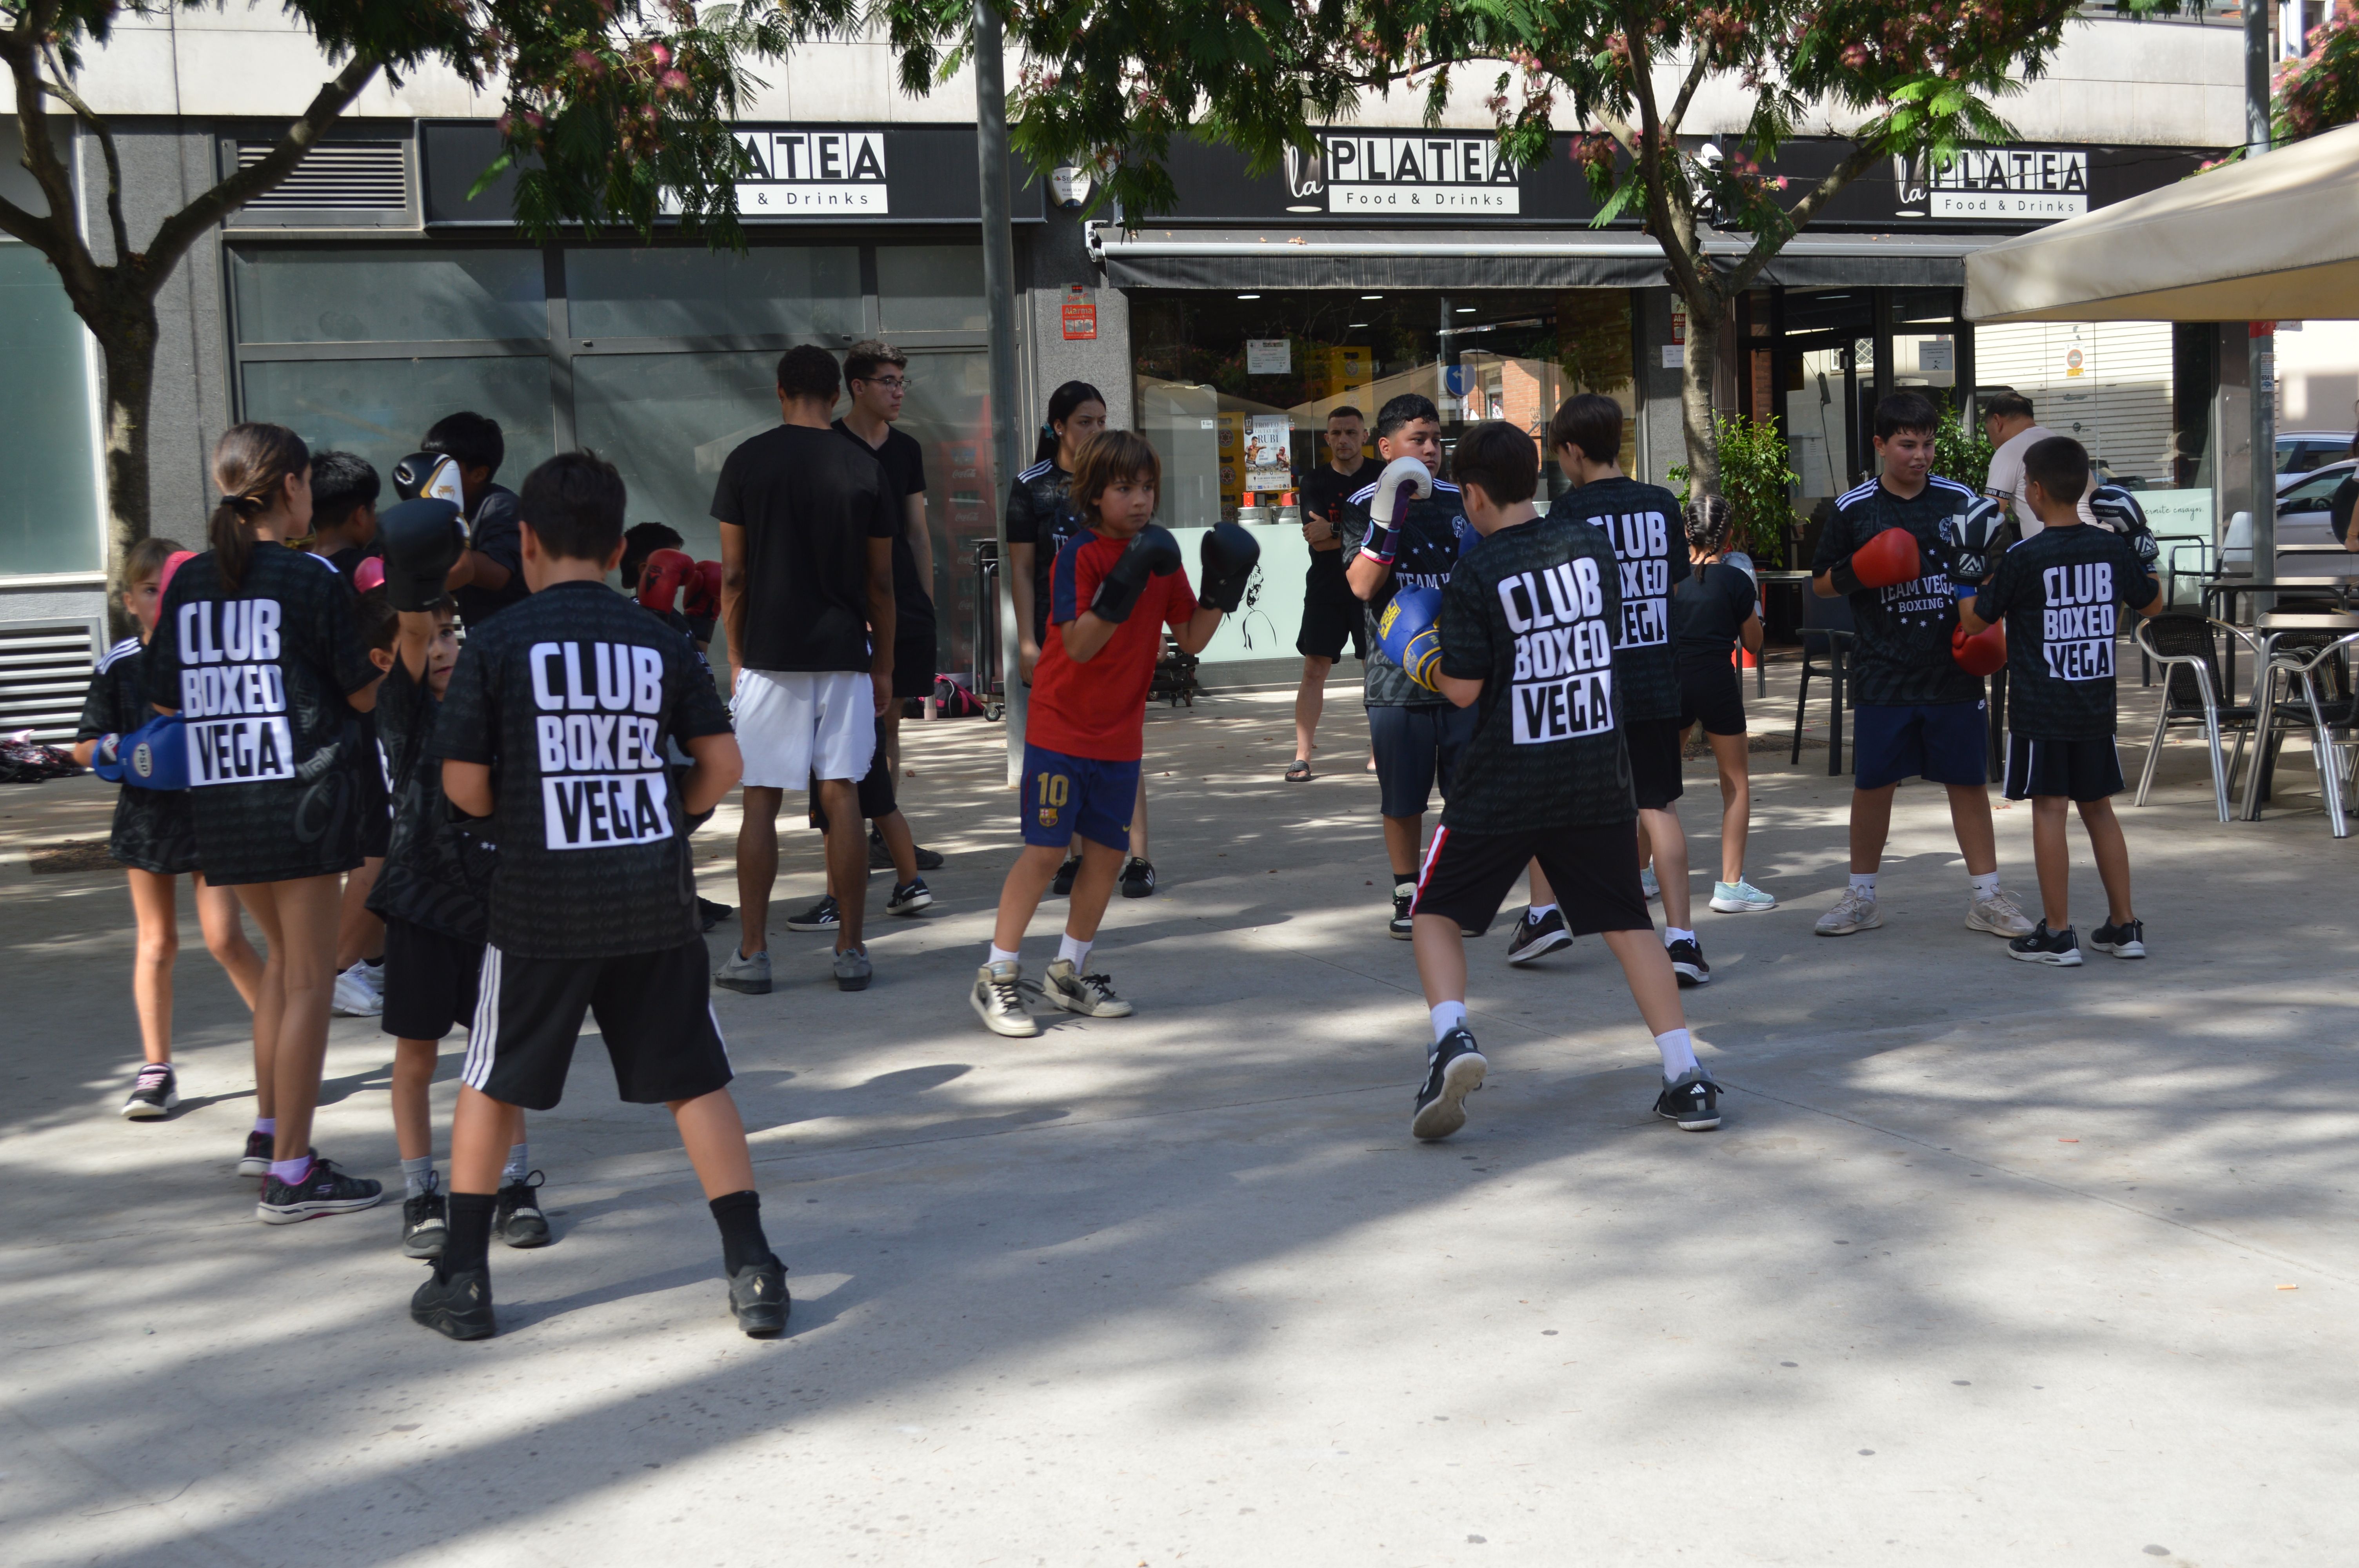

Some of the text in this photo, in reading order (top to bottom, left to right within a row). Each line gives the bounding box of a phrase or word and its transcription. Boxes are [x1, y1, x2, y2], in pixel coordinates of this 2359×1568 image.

[700, 134, 885, 180] ATEA
[1288, 139, 1518, 198] la PLATEA
[1898, 151, 2086, 204] la PLATEA
[758, 192, 868, 205] & Drinks
[1347, 192, 1503, 205] Food & Drinks
[1945, 199, 2074, 212] Food & Drinks
[2144, 505, 2170, 515] ermite
[1396, 572, 1439, 589] TEAM
[1498, 557, 1603, 634] CLUB
[1618, 559, 1668, 598] XEO
[1881, 573, 1955, 604] TEAM VEGA
[2043, 563, 2113, 606] CLUB
[1616, 601, 1665, 646] EGA
[1898, 597, 1944, 613] BOXING
[2043, 604, 2114, 640] BOXEO
[179, 599, 281, 664] CLUB
[1513, 619, 1611, 681] BOXEO
[530, 642, 663, 714] CLUB
[2050, 641, 2109, 678] VEGA
[180, 665, 286, 718] BOXEO
[1521, 676, 1609, 739] VEGA
[196, 721, 285, 781] VEGA
[536, 714, 663, 773] BOXEO
[554, 778, 663, 845] VEGA
[1038, 772, 1069, 807] 10
